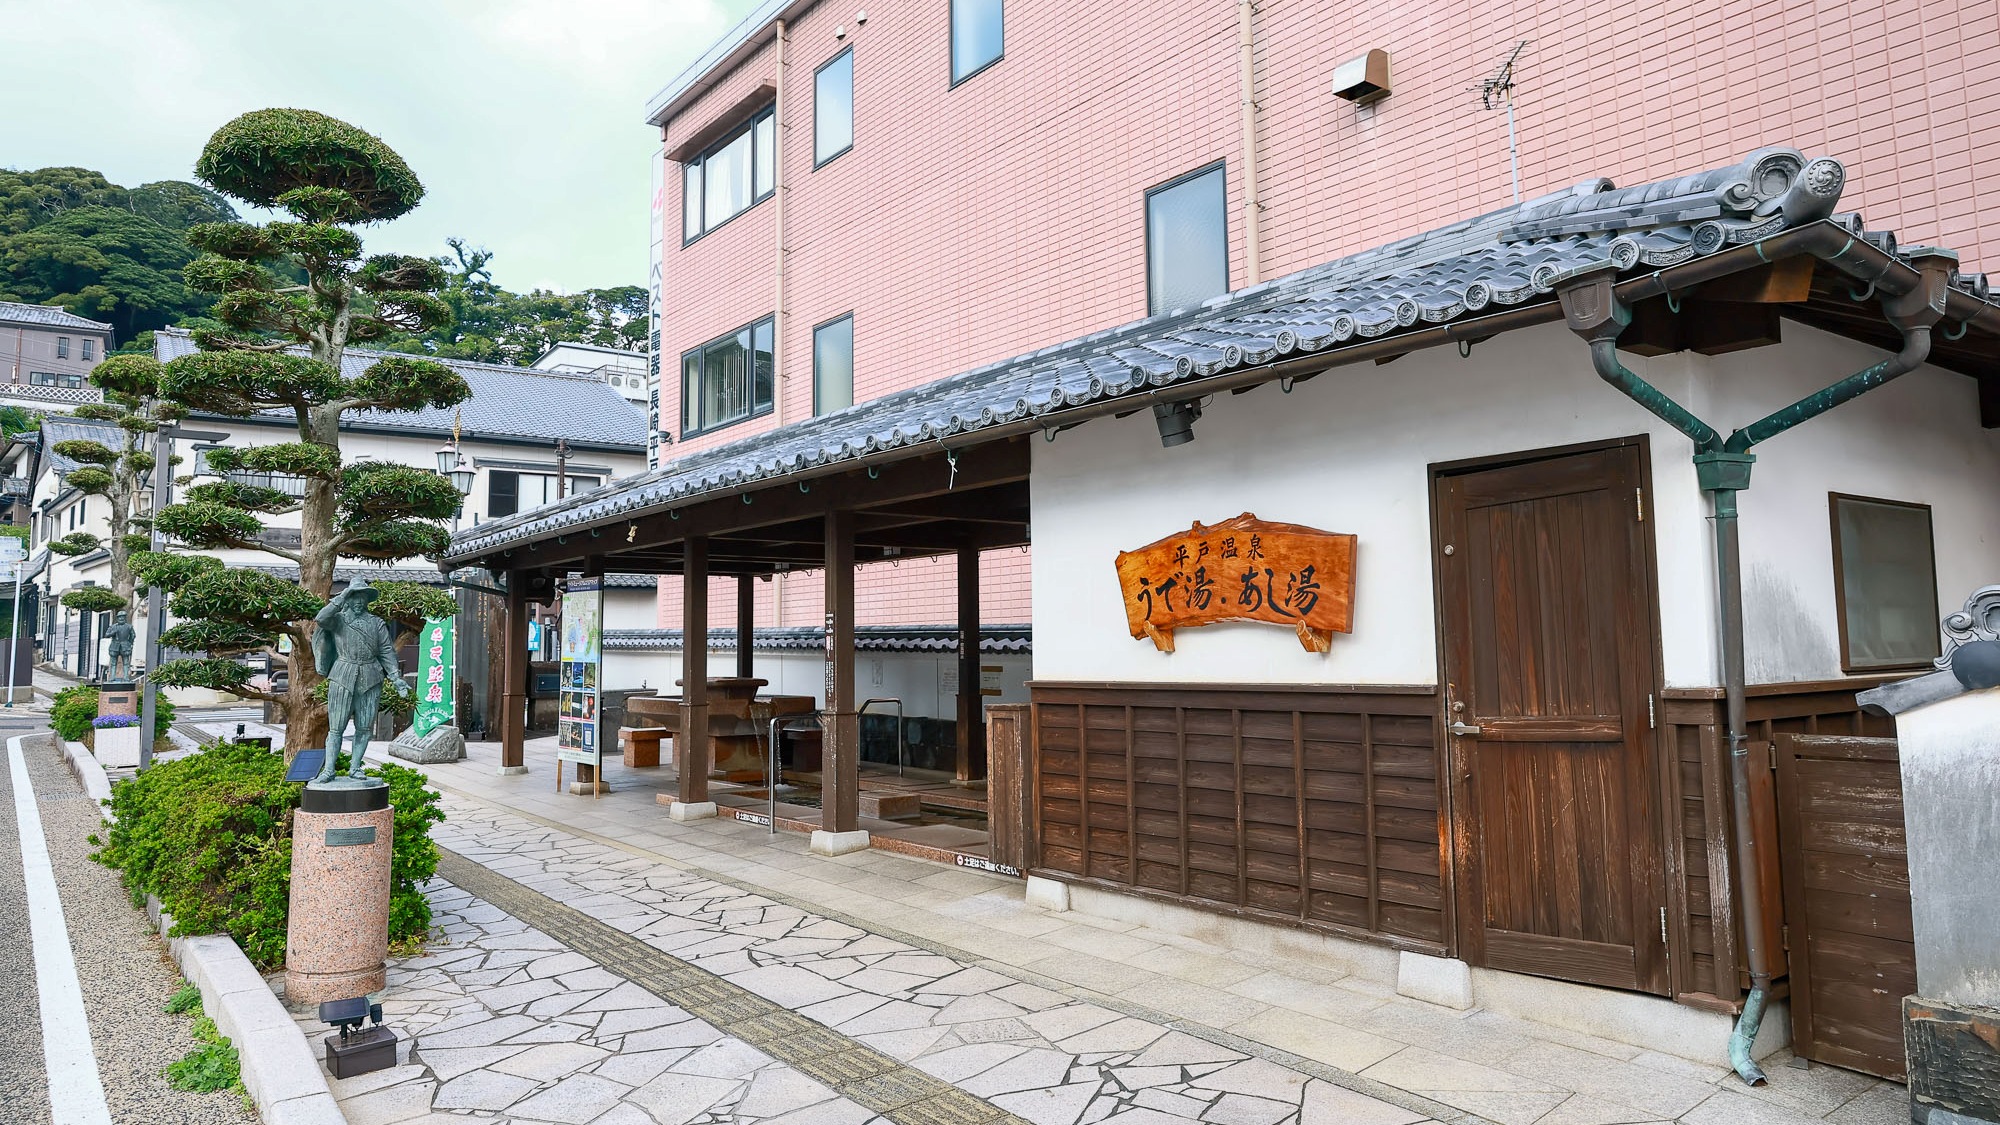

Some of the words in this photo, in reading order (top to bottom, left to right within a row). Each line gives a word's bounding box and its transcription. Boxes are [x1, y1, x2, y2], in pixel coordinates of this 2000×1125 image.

[651, 261, 662, 377] ベスト電器
[1173, 533, 1264, 568] 平戸温泉
